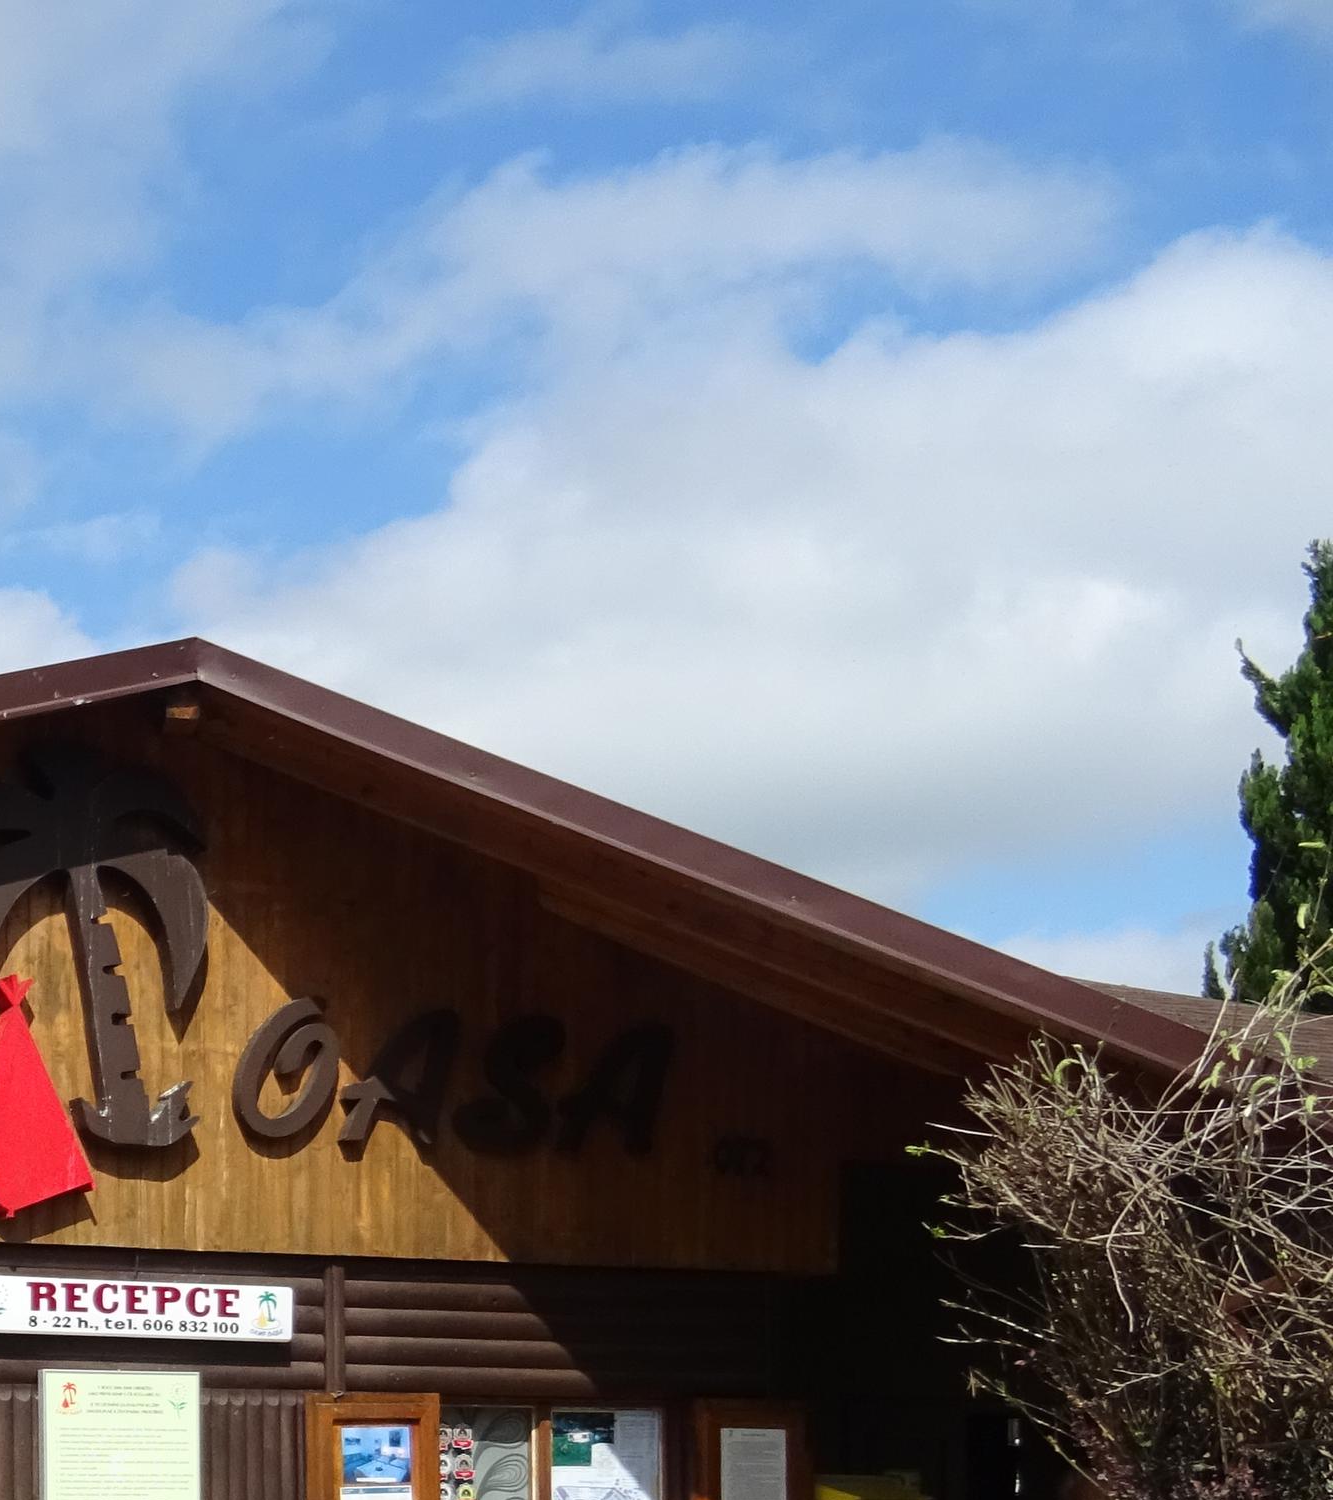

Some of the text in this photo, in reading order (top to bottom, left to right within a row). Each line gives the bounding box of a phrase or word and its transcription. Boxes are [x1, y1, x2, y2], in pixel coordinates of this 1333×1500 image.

[231, 998, 675, 1155] OASA
[26, 1281, 241, 1318] RECEPCE
[28, 1315, 38, 1328] 8
[52, 1316, 71, 1329] 22
[77, 1316, 100, 1331] h.,
[104, 1317, 138, 1331] tel.
[142, 1319, 174, 1332] 606
[178, 1321, 208, 1333] 832
[212, 1321, 240, 1334] 100
